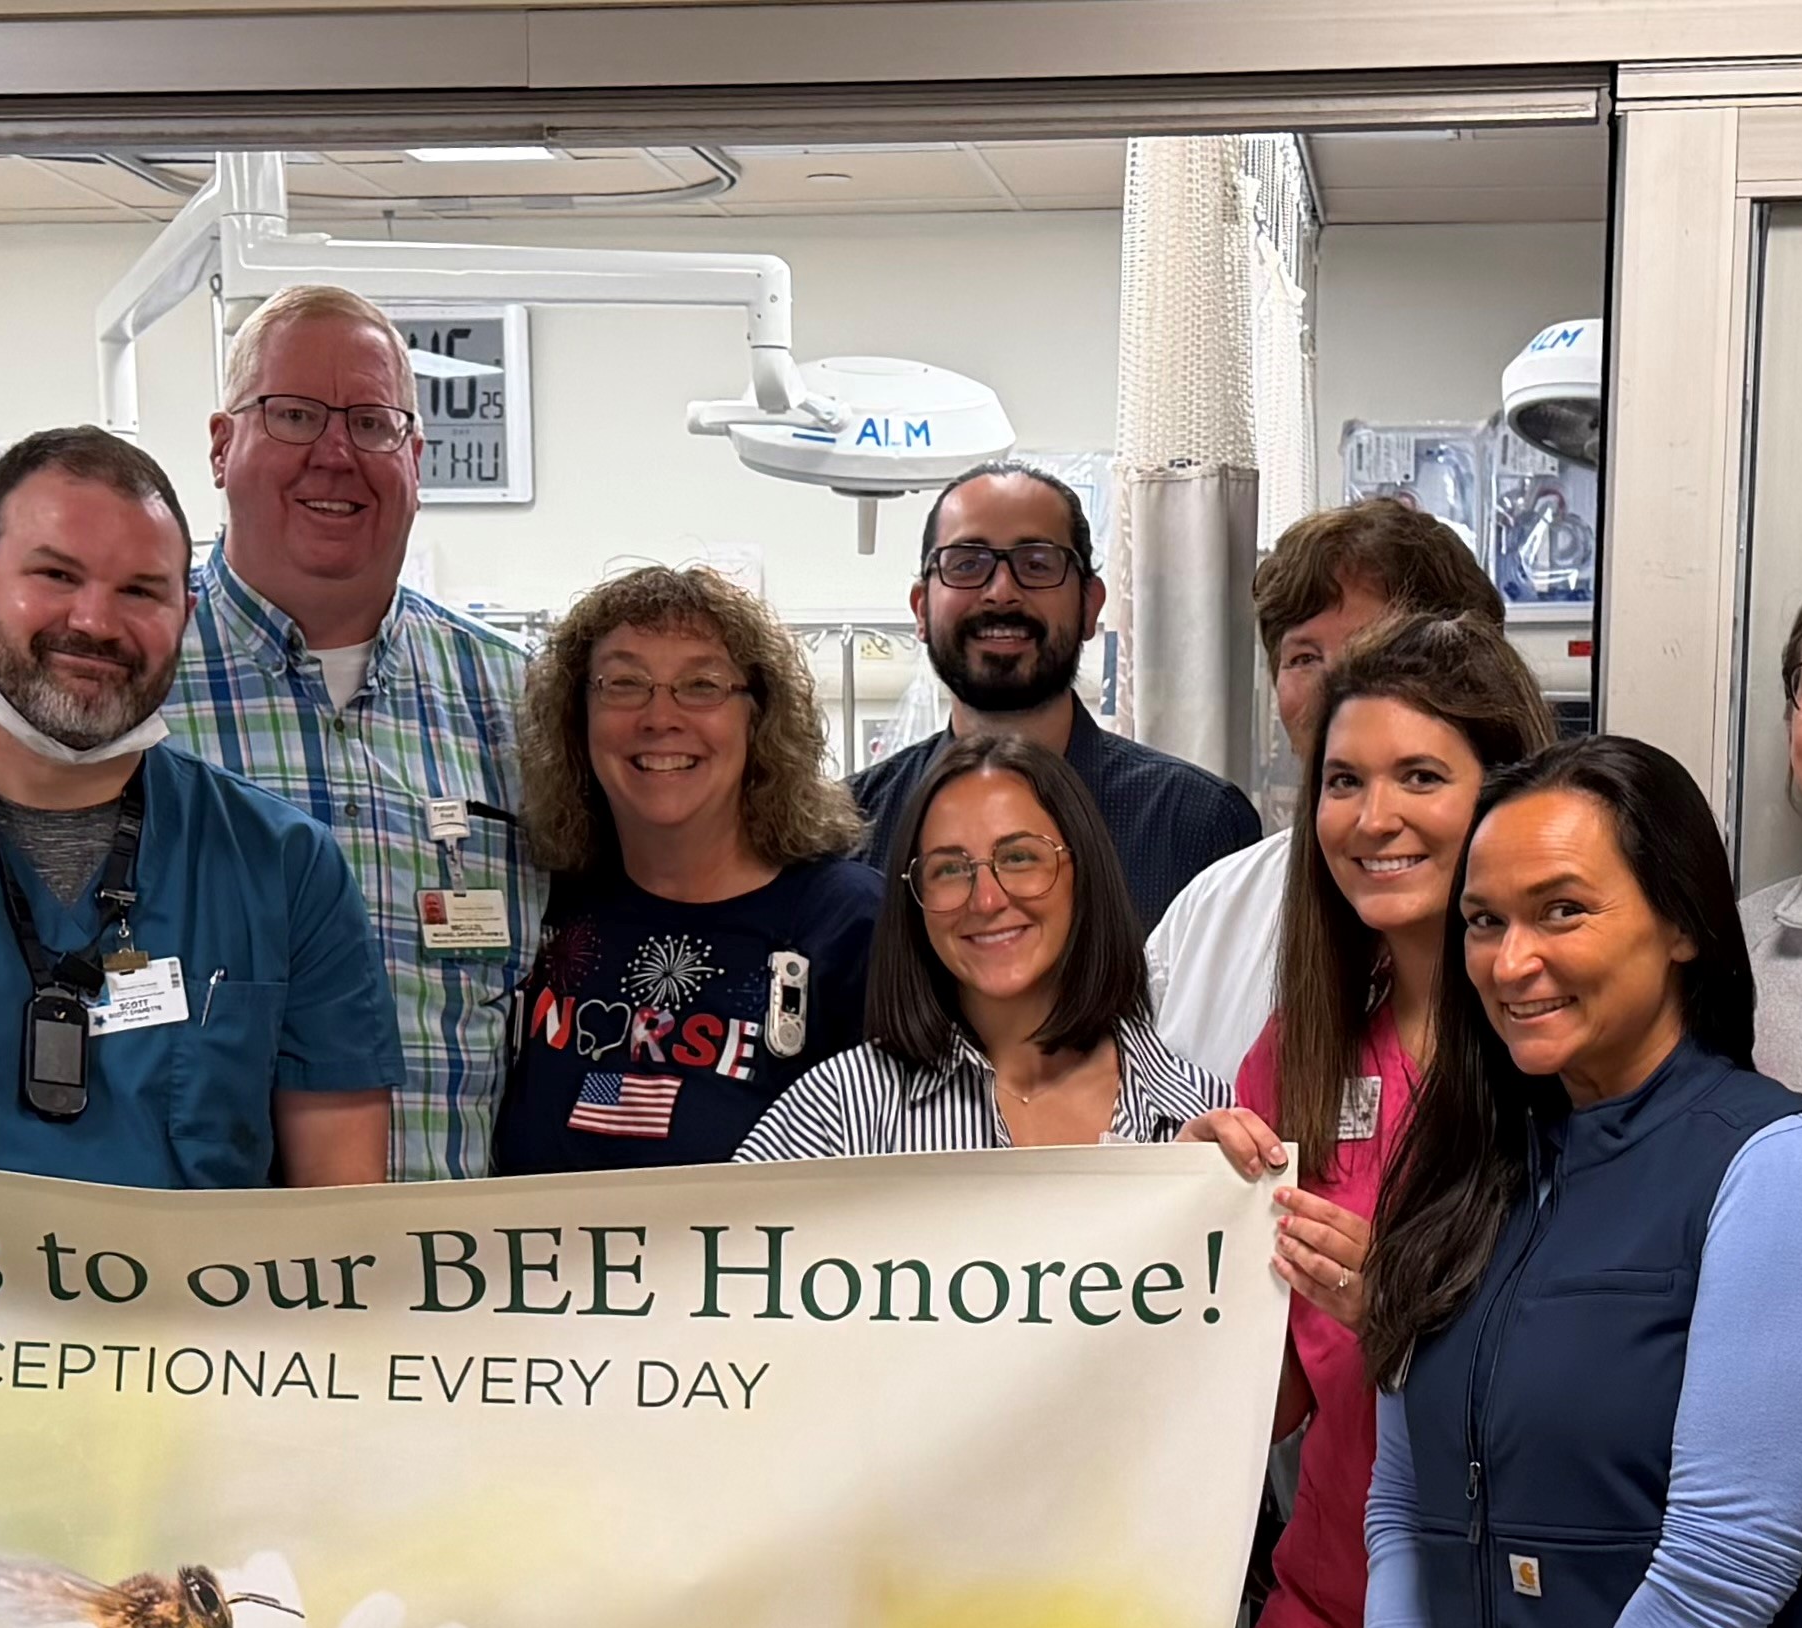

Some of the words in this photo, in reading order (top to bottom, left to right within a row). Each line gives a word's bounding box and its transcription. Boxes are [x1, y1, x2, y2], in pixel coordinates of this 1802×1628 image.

[479, 391, 505, 420] 25
[425, 439, 500, 482] THU
[36, 1232, 148, 1303] to
[187, 1255, 376, 1310] our
[406, 1226, 655, 1316] BEE
[690, 1226, 1223, 1326] Honoree!
[388, 1355, 611, 1406] EVERY
[638, 1361, 769, 1409] DAY
